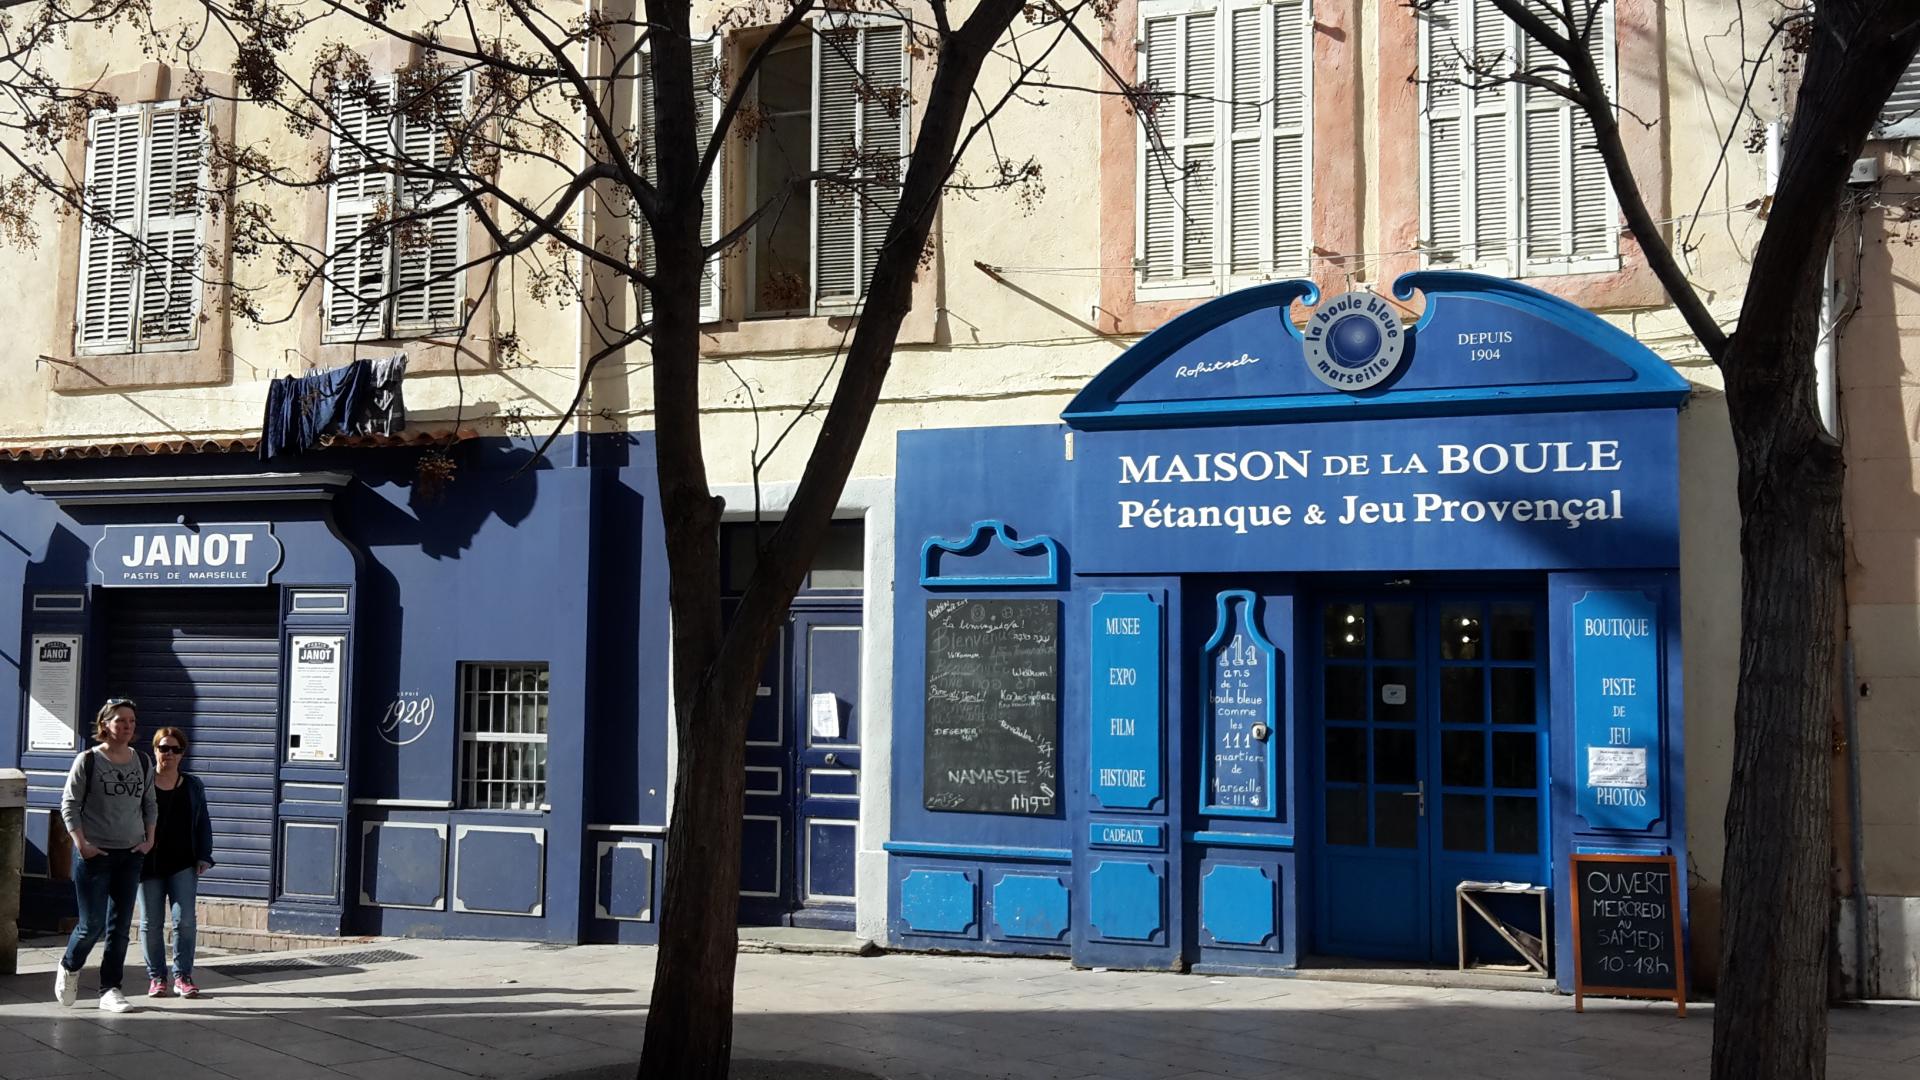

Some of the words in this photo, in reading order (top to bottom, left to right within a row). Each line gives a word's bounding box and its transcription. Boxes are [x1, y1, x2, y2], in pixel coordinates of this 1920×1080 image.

[1305, 326, 1322, 341] la
[1316, 294, 1362, 324] boule
[1366, 297, 1398, 338] bleue
[1458, 331, 1512, 345] DEPUIS
[1471, 349, 1501, 361] 1904
[1317, 357, 1389, 384] marseille
[1118, 450, 1312, 484] MAISON
[1323, 455, 1369, 476] DE
[1381, 453, 1428, 474] LA
[1438, 440, 1623, 474] BOULE
[1118, 499, 1292, 534] Pétanque
[1303, 504, 1326, 525] &
[1339, 495, 1406, 524] Jeu
[1413, 490, 1623, 529] Provençal
[122, 533, 253, 567] JANOT
[124, 572, 159, 580] PASTIS
[189, 571, 247, 579] MARSEILLE
[1106, 618, 1141, 635] MUSEE
[1585, 618, 1649, 639] BOUTIQUE
[41, 649, 69, 659] JANOT
[301, 649, 331, 660] JANOT
[1219, 634, 1257, 666] 111
[1109, 668, 1136, 686] EXPO
[1223, 669, 1250, 678] ans
[1220, 681, 1231, 689] de
[1238, 679, 1248, 688] la
[1602, 678, 1636, 696] PISTE
[1209, 689, 1234, 704] boule
[1237, 690, 1263, 705] bleue
[383, 697, 430, 733] 1928
[1217, 708, 1256, 716] comme
[1613, 706, 1626, 717] DE
[1110, 718, 1135, 736] FILM
[1230, 718, 1244, 730] les
[1222, 732, 1251, 749] 111
[1609, 727, 1631, 745] JEU
[948, 769, 1030, 785] NAMASTE
[1231, 764, 1243, 774] de
[1100, 769, 1146, 788] HISTOIRE
[1212, 778, 1262, 793] Marseille
[104, 780, 143, 798] LOVE
[1597, 787, 1647, 807] PHOTOS
[1103, 828, 1144, 844] CADEAUX
[1587, 871, 1670, 895] OUVERT
[1593, 899, 1666, 919] MERCREDI
[1617, 920, 1632, 930] AU
